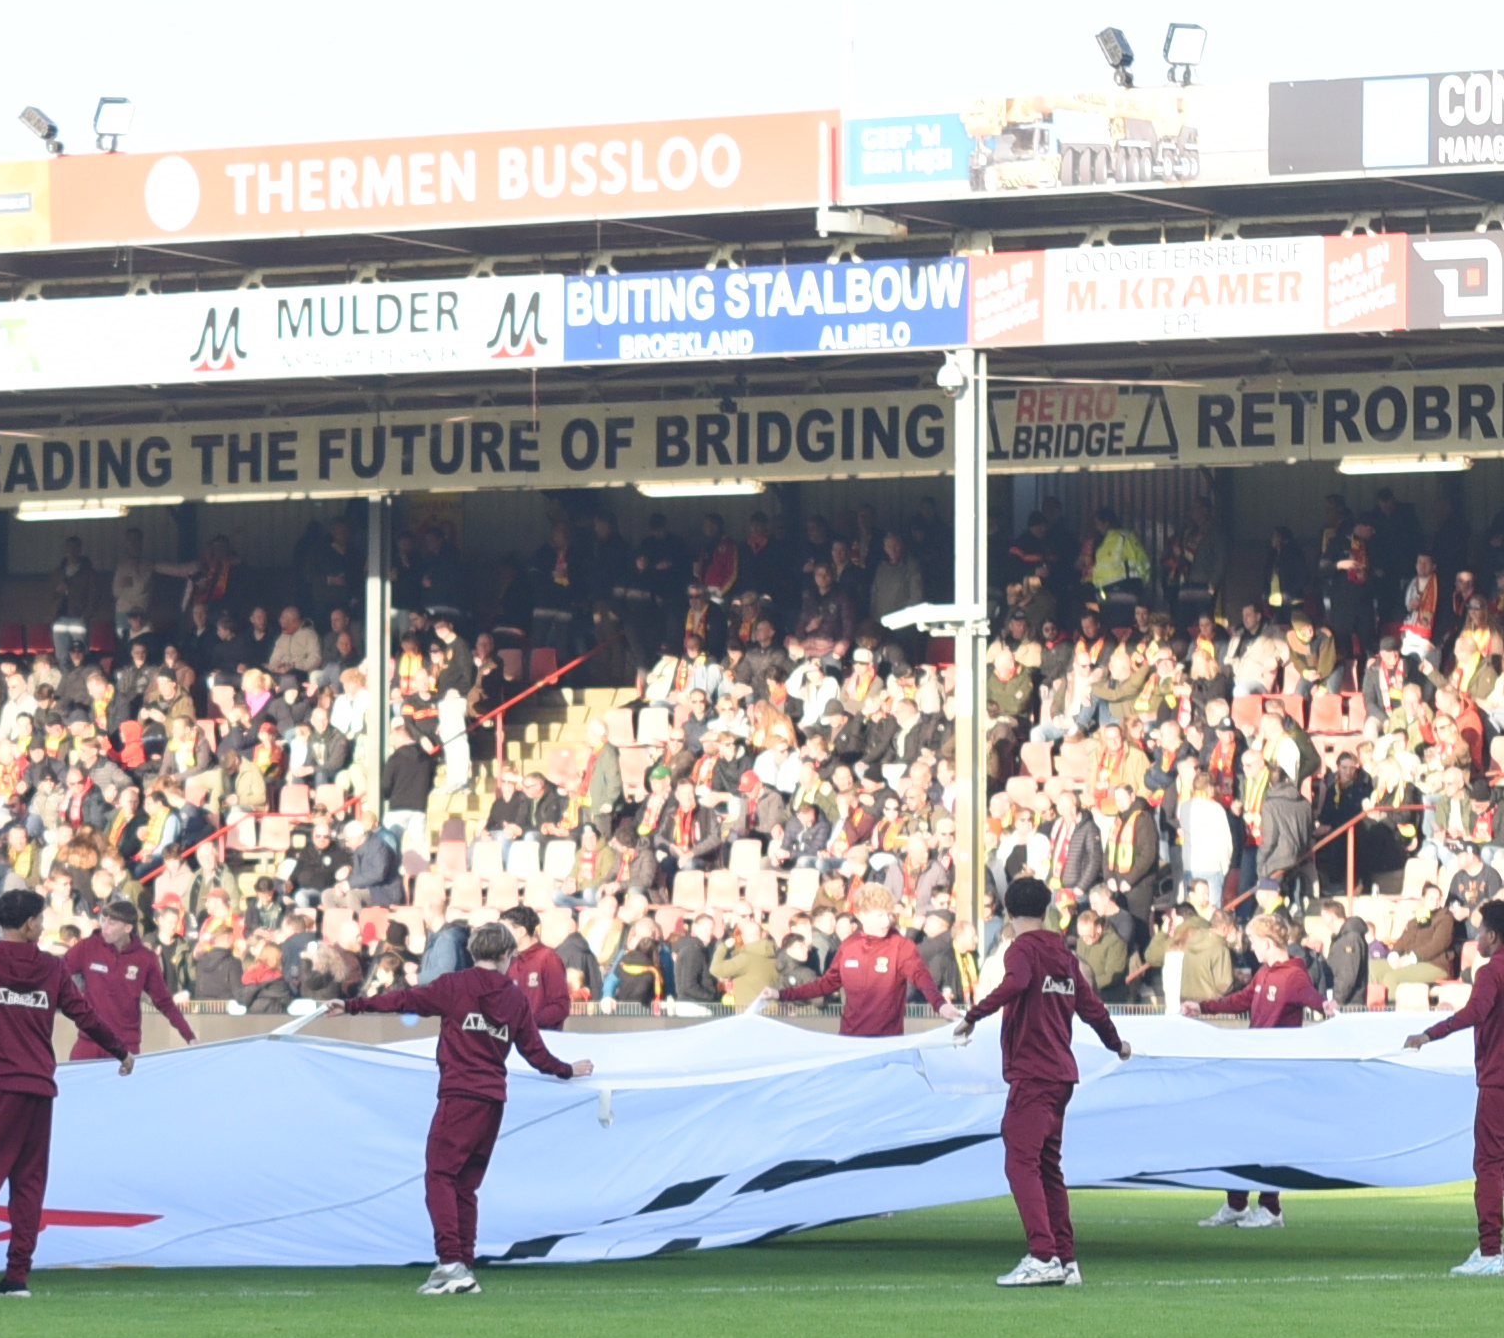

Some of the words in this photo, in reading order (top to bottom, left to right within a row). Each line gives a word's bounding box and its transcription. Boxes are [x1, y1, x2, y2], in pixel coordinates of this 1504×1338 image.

[225, 149, 477, 215] THERMEN
[497, 133, 742, 200] BUSSLOO
[1064, 242, 1304, 274] LOODGIETERSBEDRIJF
[566, 276, 716, 327] BUITING
[725, 263, 966, 317] STAALBOUW
[1119, 270, 1303, 309] KRAMER
[276, 291, 459, 339] MULDER
[1163, 312, 1203, 334] EPE
[618, 330, 754, 361] BROEKLAND
[819, 322, 911, 351] ALMELO
[1014, 385, 1119, 425] RETRO
[192, 430, 298, 486] THE
[319, 421, 541, 480] FUTURE
[560, 417, 635, 471] OF
[656, 404, 947, 468] BRIDGING
[1012, 421, 1126, 461] BRIDGE
